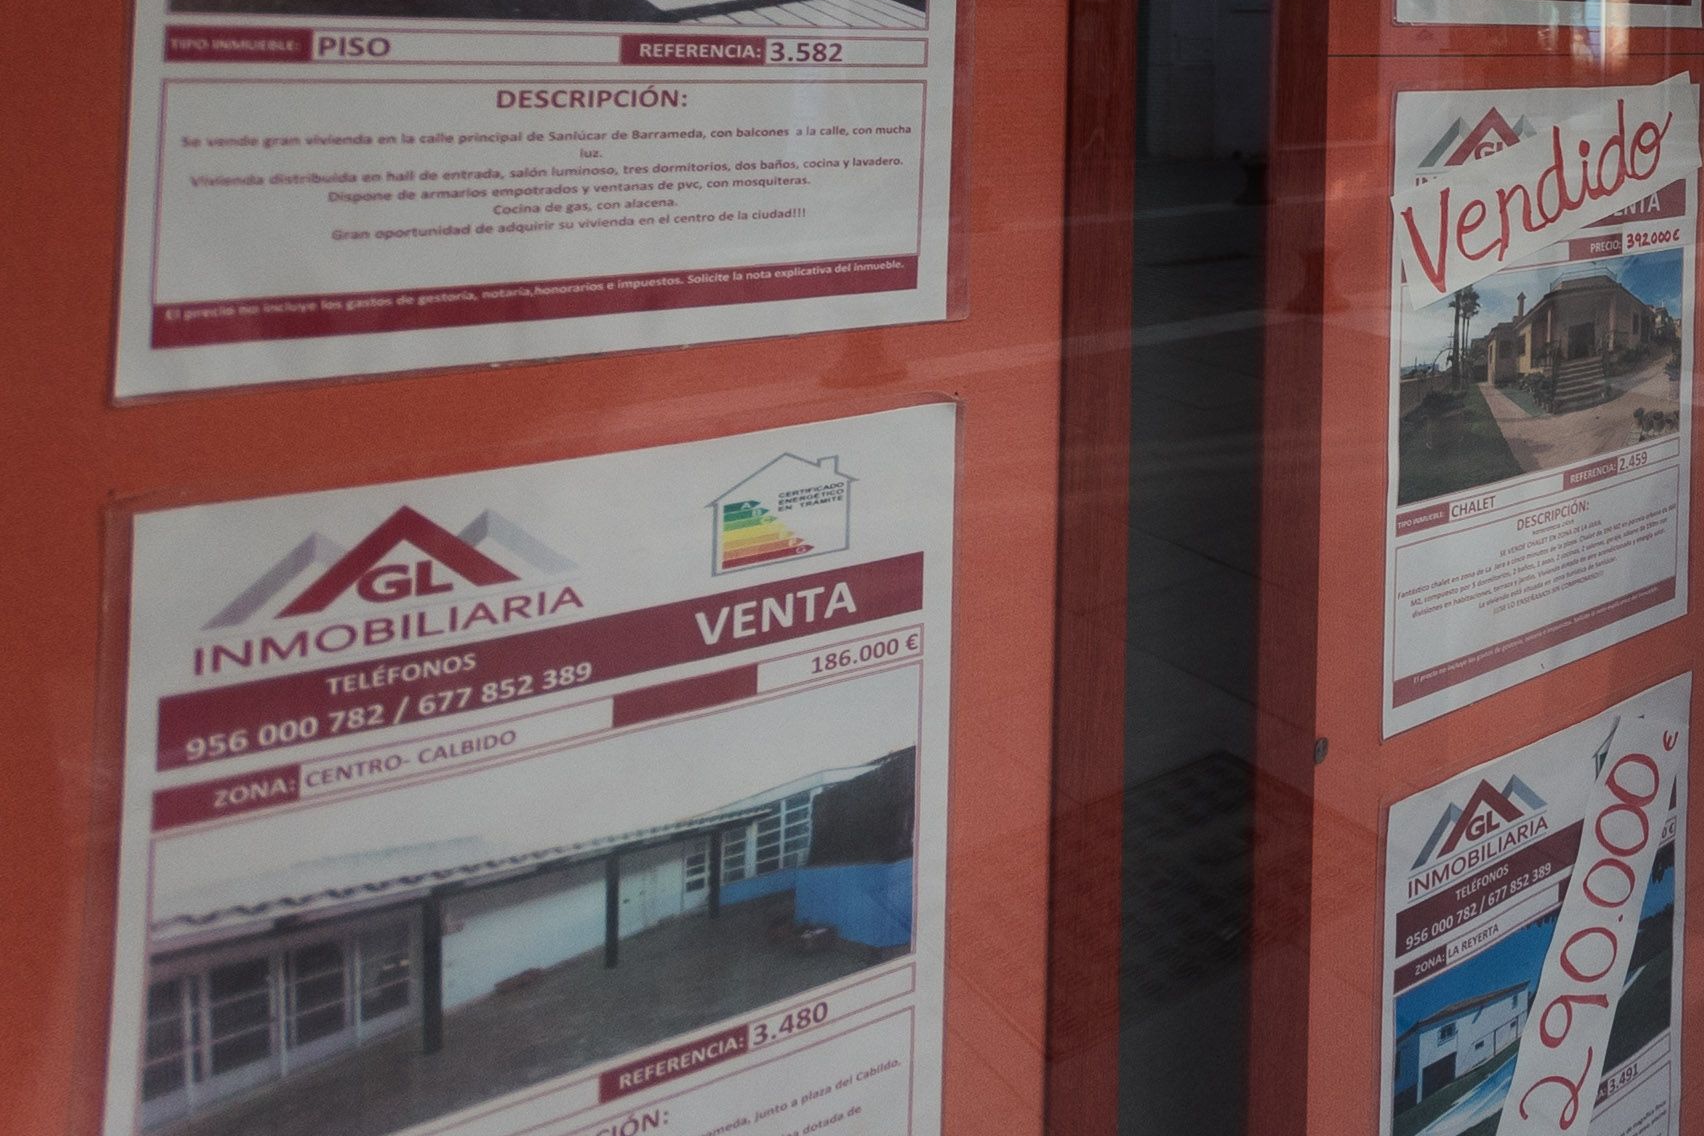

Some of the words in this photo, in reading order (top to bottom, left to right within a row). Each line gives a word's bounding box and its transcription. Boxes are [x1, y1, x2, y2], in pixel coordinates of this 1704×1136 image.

[317, 37, 391, 57] PISO
[639, 43, 761, 60] REFERENCIA:
[770, 42, 843, 63] 3.582
[496, 85, 688, 109] DESCRIPCIÓN:
[458, 131, 522, 145] principal
[527, 132, 544, 143] de
[549, 129, 607, 141] Sanlúcar
[611, 130, 628, 141] de
[632, 128, 706, 141] Barrameda,
[711, 129, 732, 139] con
[737, 127, 789, 138] balcones
[820, 125, 849, 137] calle,
[852, 126, 872, 135] con
[876, 125, 911, 135] mucha
[623, 165, 648, 175] tres
[652, 161, 731, 174] dormitorios,
[734, 161, 756, 171] dos
[760, 159, 799, 171] baños,
[803, 159, 839, 169] cocina
[853, 156, 903, 167] lavadero.
[1401, 98, 1674, 293] Vendido
[1590, 239, 1622, 253] PRECIO:
[688, 273, 729, 284] Solicite
[746, 270, 771, 280] nota
[774, 266, 832, 279] explicativa
[834, 264, 851, 274] del
[853, 261, 904, 272] inmueble.
[1570, 463, 1617, 485] REFERENCIA:
[1619, 451, 1648, 472] 2.459
[778, 481, 845, 499] CERTIFICADO
[1451, 496, 1496, 518] CHALET
[1517, 500, 1589, 531] DESCRIPCIÓN:
[356, 561, 454, 604] GL
[193, 586, 584, 676] INMOBILIARIA
[695, 581, 856, 646] VENTA
[811, 638, 899, 674] 186.000
[906, 633, 919, 650] €
[325, 653, 477, 695] TELÉFONOS
[185, 730, 248, 761] 956
[258, 717, 318, 747] 000
[328, 704, 384, 733] 782
[393, 697, 411, 726] /
[418, 686, 471, 716] 677
[481, 674, 534, 703] 852
[543, 661, 593, 691] 389
[213, 777, 297, 809] ZONA:
[418, 729, 517, 764] CALBIDO
[1465, 813, 1501, 841] GL
[1407, 815, 1548, 900] INMOBILIARIA
[1455, 864, 1509, 902] TELÉFONOS
[1406, 927, 1429, 950] 956
[1431, 916, 1454, 939] 000
[1456, 904, 1477, 927] 782
[1487, 888, 1508, 911] 677
[1510, 876, 1530, 898] 852
[1532, 863, 1552, 885] 389
[1414, 952, 1445, 977] ZONA:
[1447, 944, 1460, 960] LA
[1461, 922, 1500, 952] REYERTA
[619, 1035, 744, 1090] REFERENCIA:
[752, 1002, 829, 1046] 3.480
[802, 1085, 832, 1105] plaza
[835, 1076, 852, 1091] del
[856, 1060, 902, 1081] Cabildo.
[1609, 1063, 1639, 1093] 3.491
